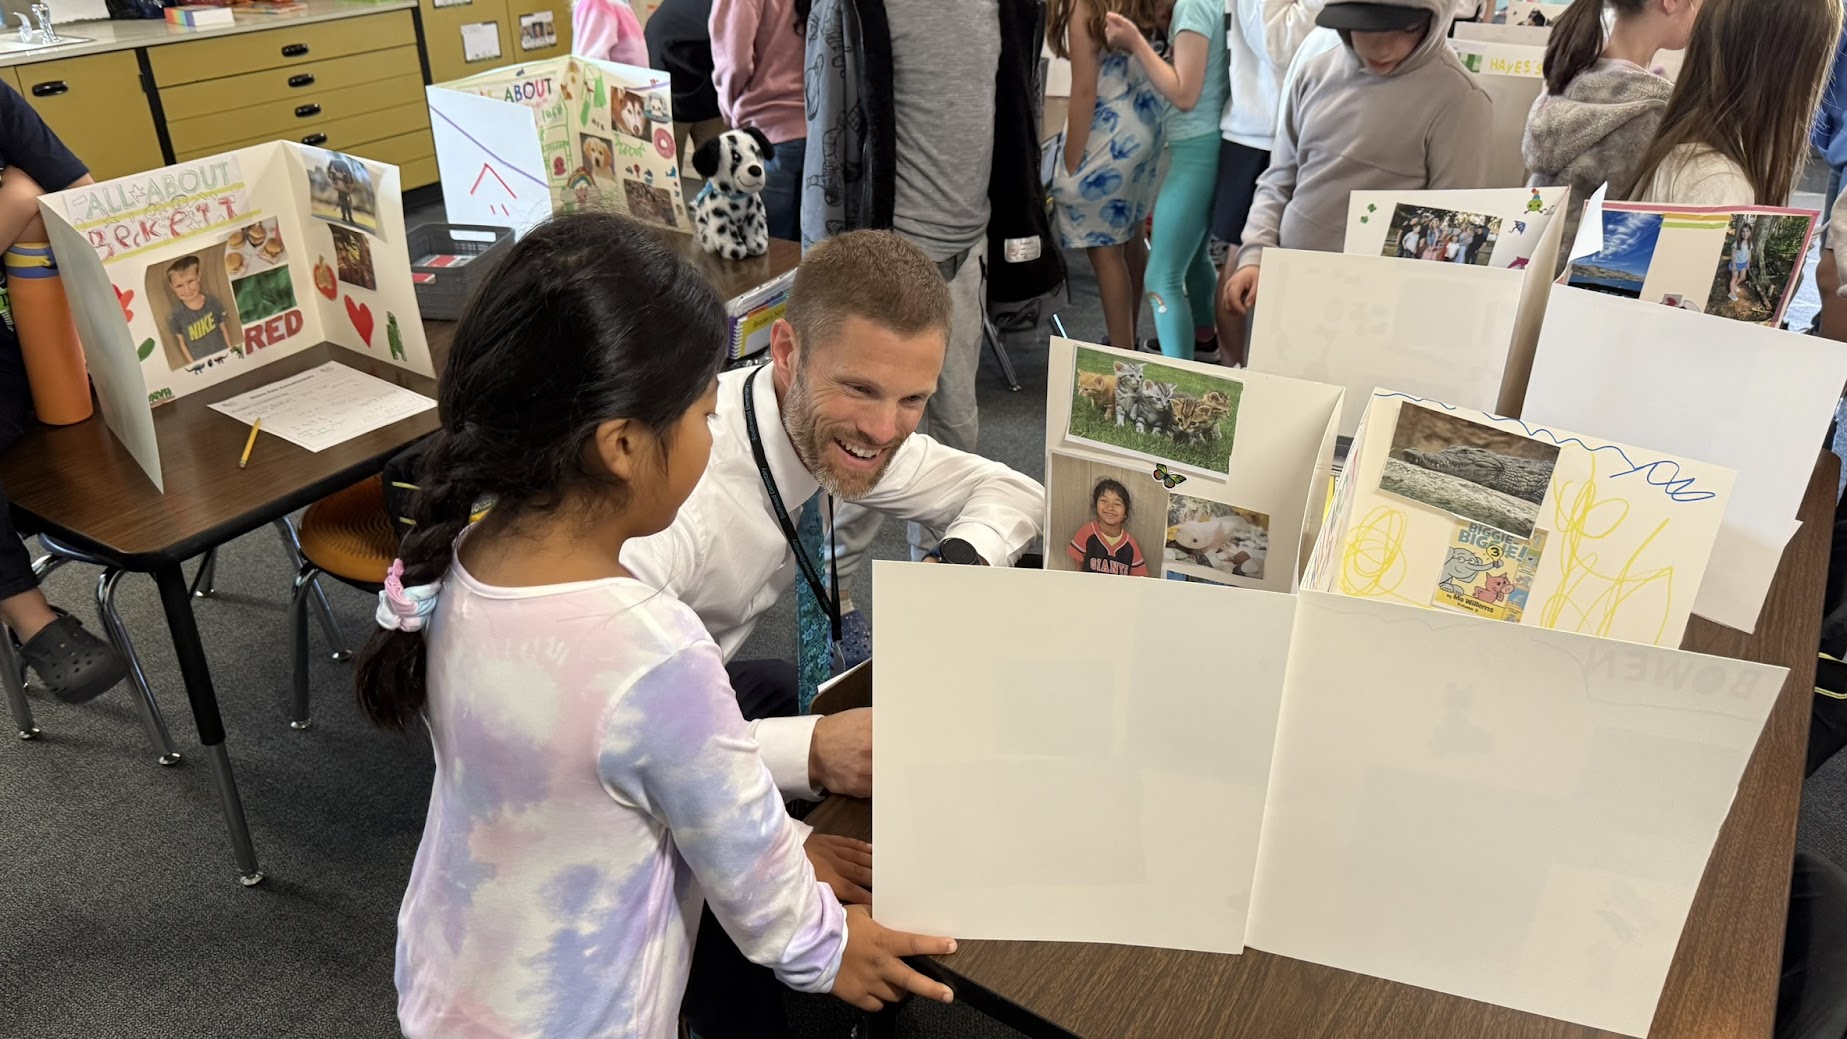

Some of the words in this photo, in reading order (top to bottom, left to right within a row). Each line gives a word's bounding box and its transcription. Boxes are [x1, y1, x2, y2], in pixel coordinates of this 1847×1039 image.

[504, 78, 552, 104] ABOUT
[86, 183, 136, 220] ALL
[146, 161, 231, 203] ABOUT
[187, 310, 217, 342] NIKE
[244, 308, 304, 355] RED
[1457, 528, 1529, 563] BIGIE!
[1490, 546, 1501, 558] 3
[1453, 594, 1465, 604] Mo
[1465, 598, 1495, 614] Willems
